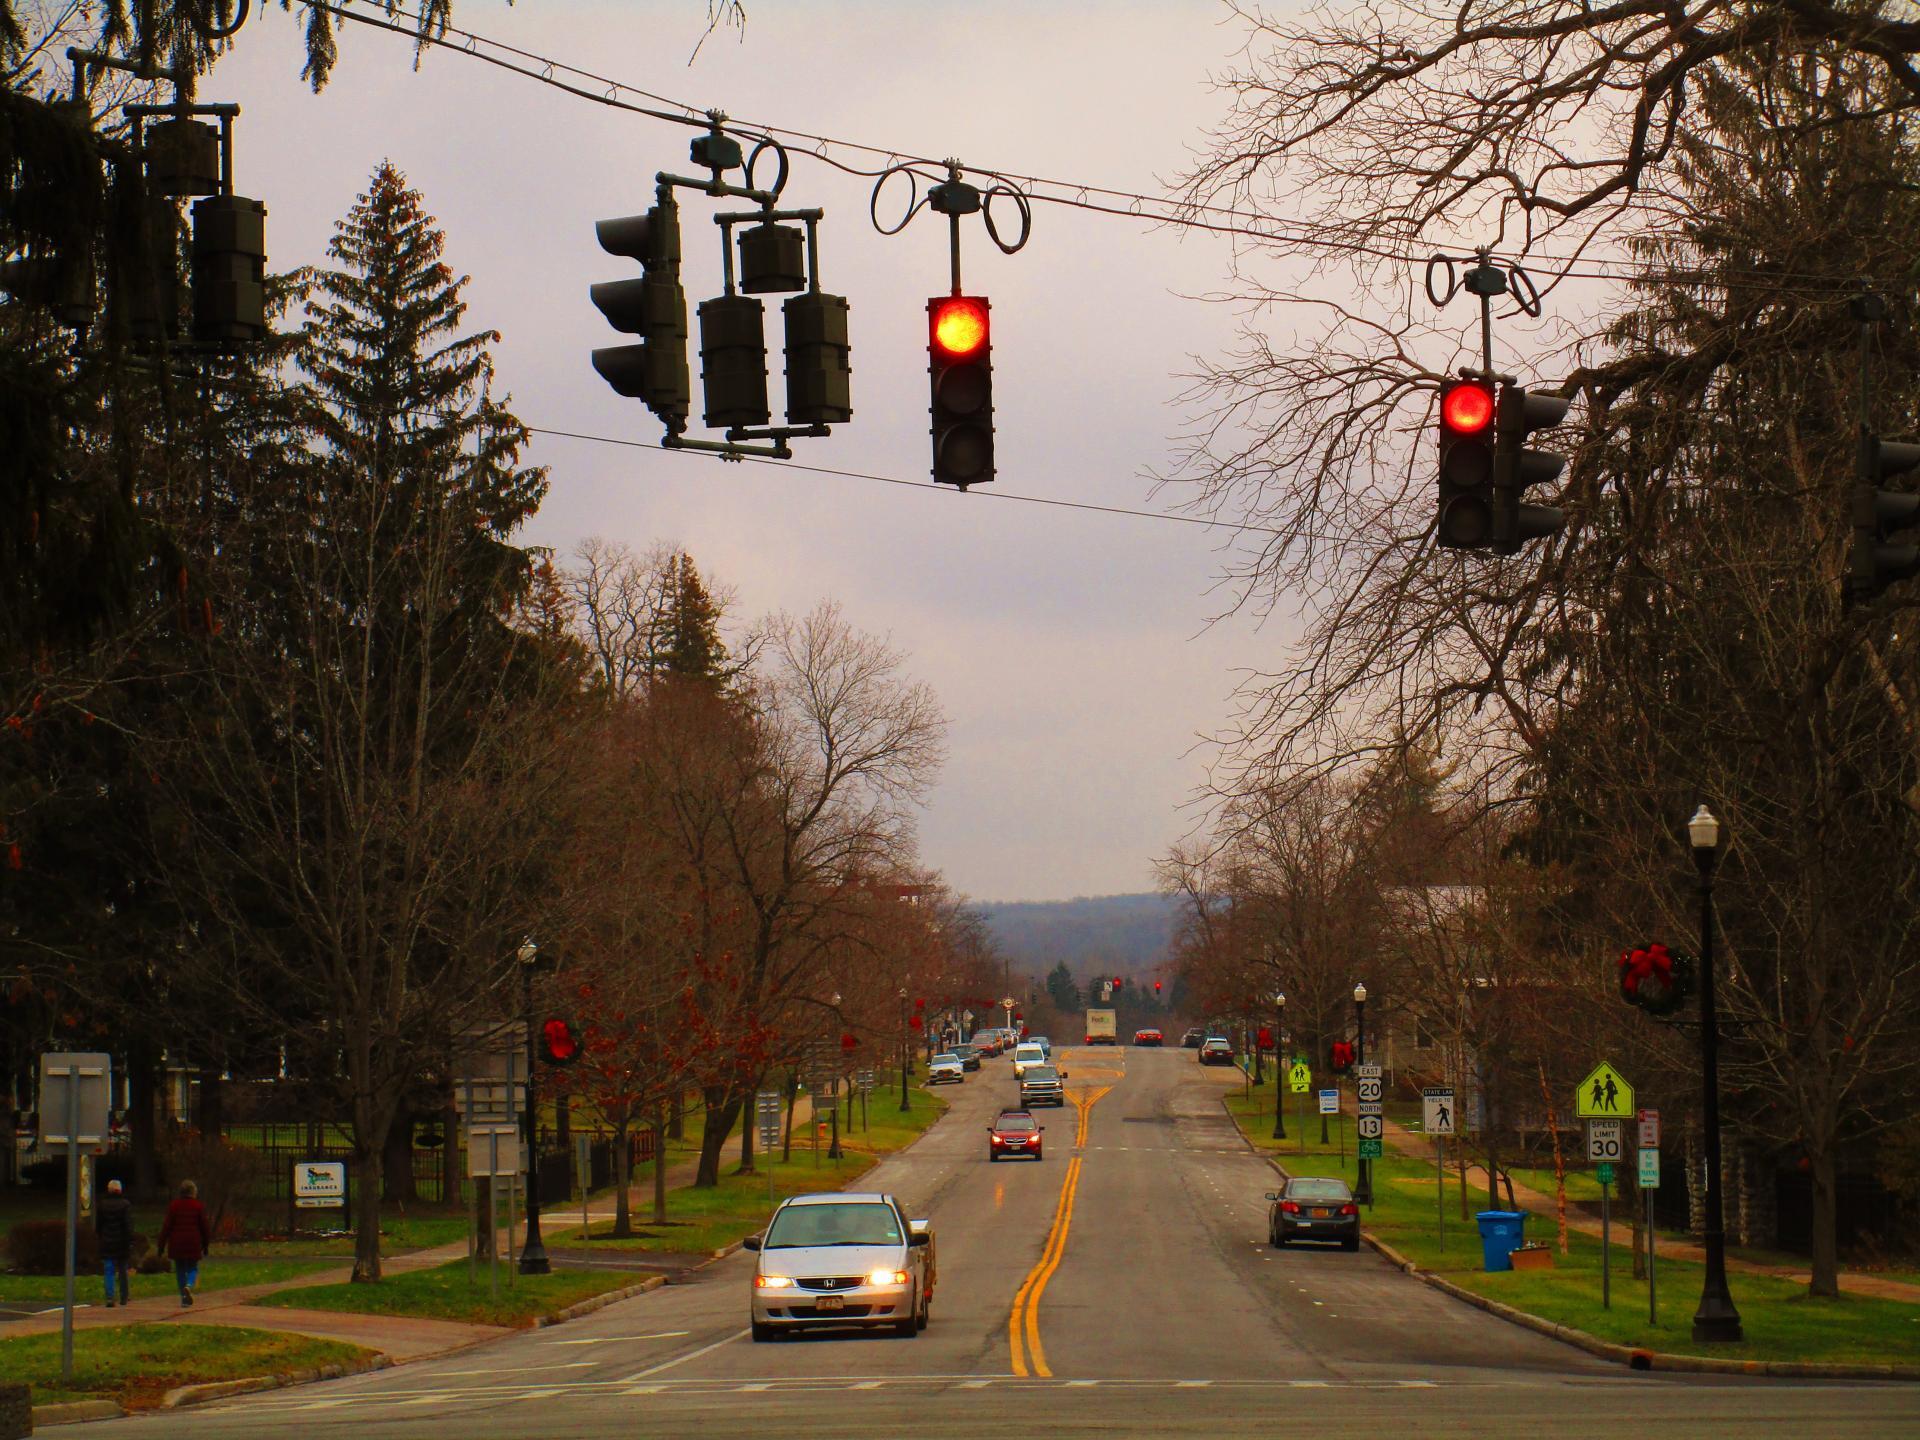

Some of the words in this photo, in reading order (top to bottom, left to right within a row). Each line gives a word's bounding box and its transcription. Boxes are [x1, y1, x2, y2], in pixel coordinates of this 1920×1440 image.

[1361, 1067, 1379, 1075] EAST
[1360, 1083, 1380, 1096] 20
[1363, 1121, 1378, 1133] 13
[1594, 1130, 1615, 1138] LIMIT
[1592, 1140, 1619, 1156] 30
